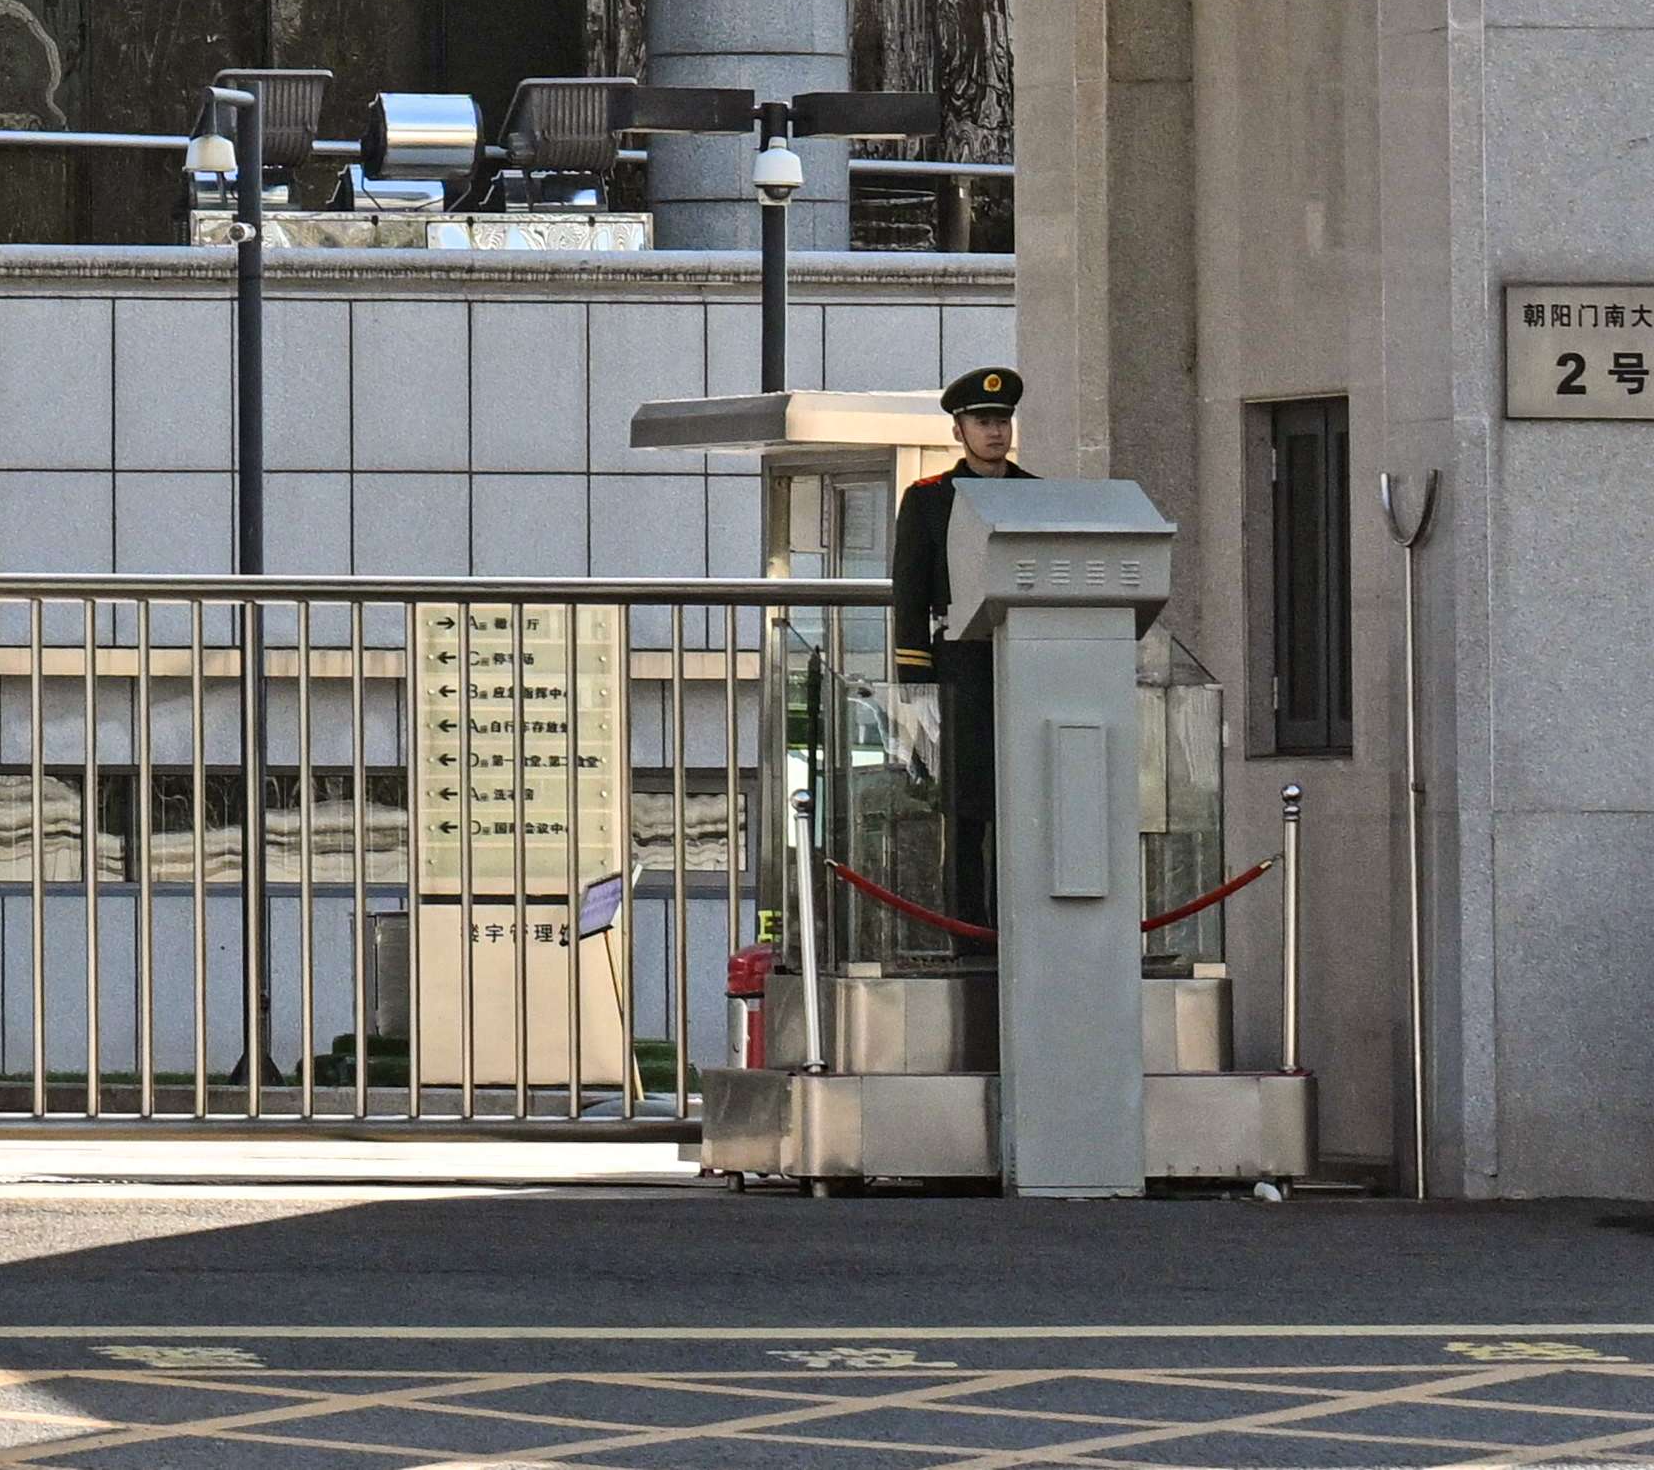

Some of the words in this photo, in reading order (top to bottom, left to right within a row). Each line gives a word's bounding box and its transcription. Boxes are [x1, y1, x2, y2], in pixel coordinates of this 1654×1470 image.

[1522, 303, 1653, 329] 朝阳门南大
[1556, 352, 1650, 395] 2号
